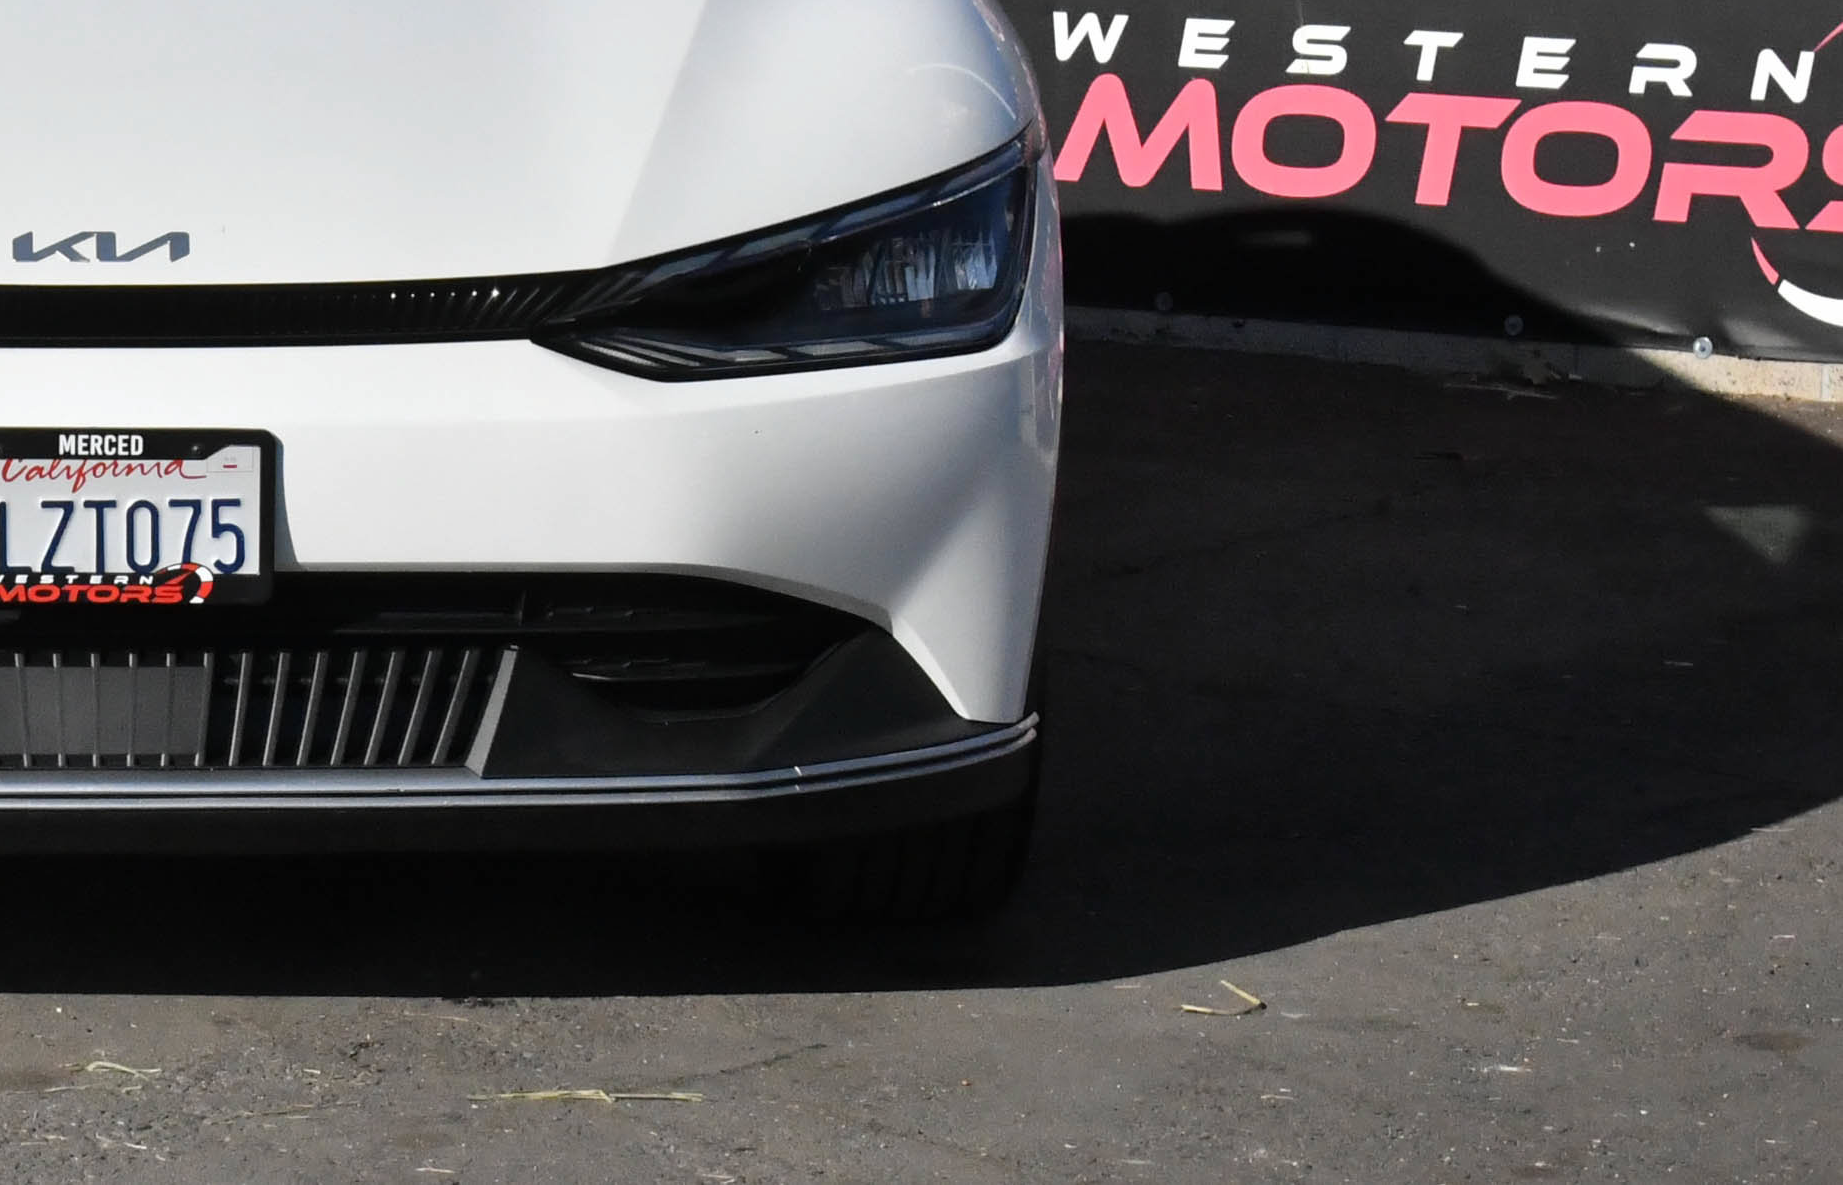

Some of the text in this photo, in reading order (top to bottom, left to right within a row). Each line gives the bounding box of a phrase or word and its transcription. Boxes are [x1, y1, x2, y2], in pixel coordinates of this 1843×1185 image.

[1052, 11, 1816, 104] WESTERN
[1053, 72, 1843, 233] MOTOR
[12, 231, 190, 263] KIA
[58, 434, 144, 456] MERCED
[2, 458, 207, 493] California
